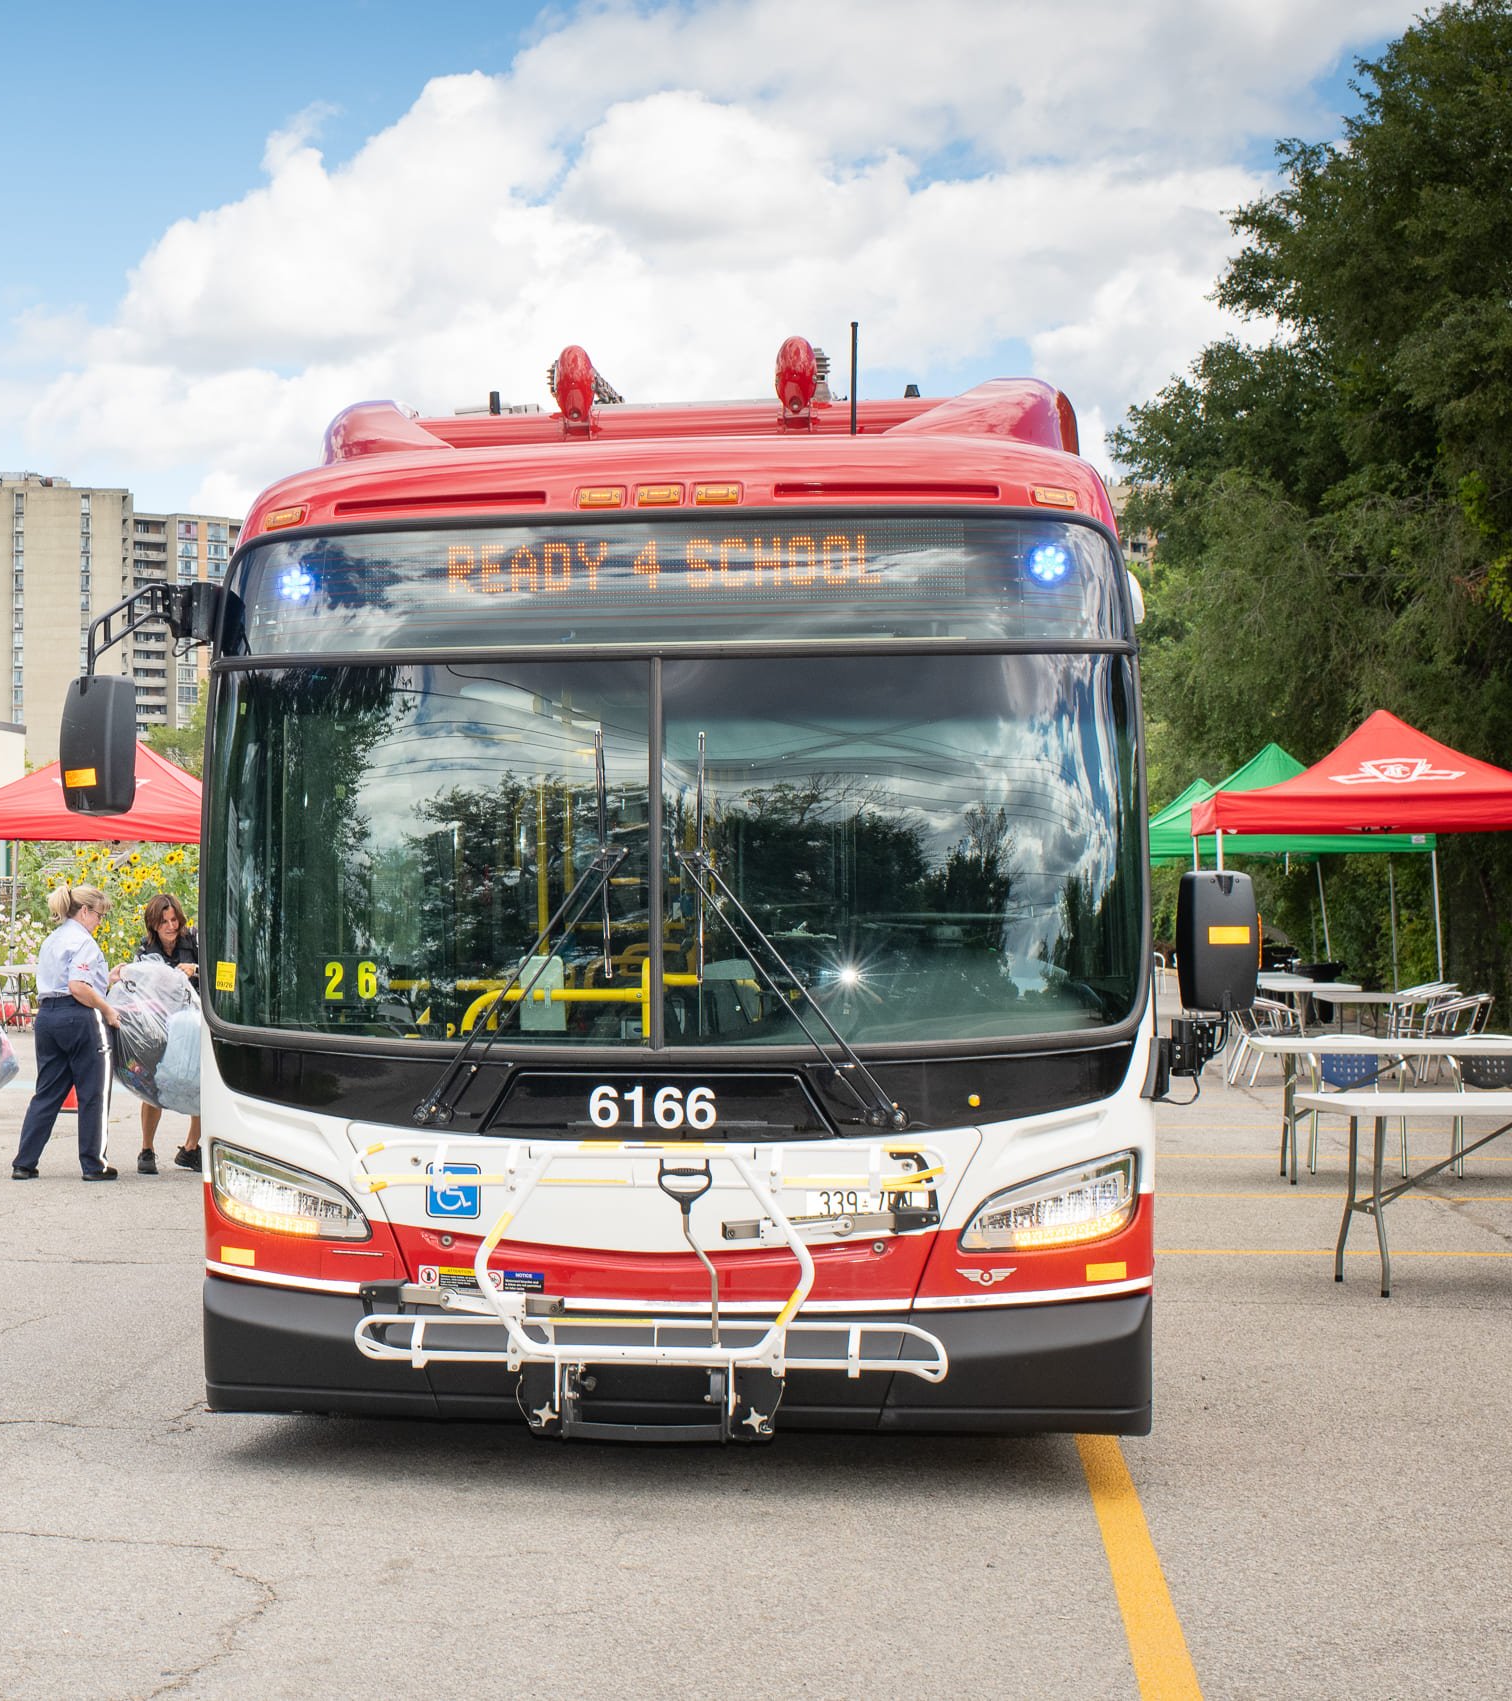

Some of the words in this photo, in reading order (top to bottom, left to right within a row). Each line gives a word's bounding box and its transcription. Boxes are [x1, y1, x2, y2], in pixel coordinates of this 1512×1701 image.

[447, 541, 608, 593] READY
[633, 540, 661, 589] 4
[686, 534, 881, 588] SCHOOL
[589, 1085, 717, 1130] 6166
